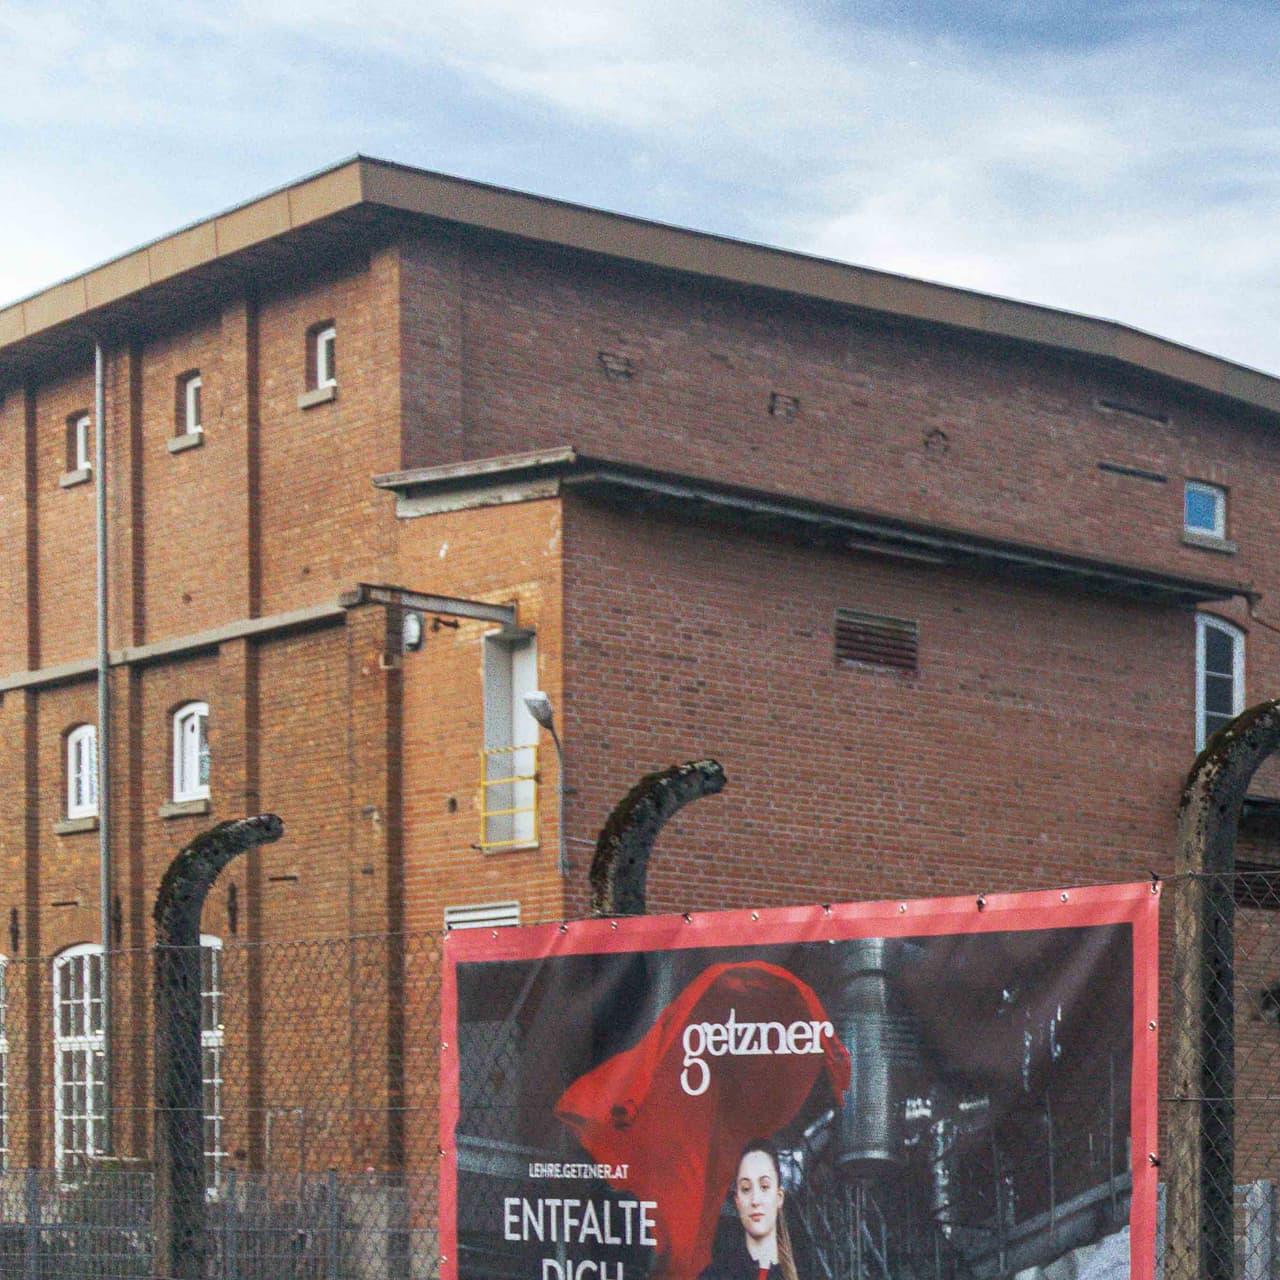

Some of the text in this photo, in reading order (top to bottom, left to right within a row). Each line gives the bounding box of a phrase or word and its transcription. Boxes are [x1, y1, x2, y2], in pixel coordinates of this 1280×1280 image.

[680, 1008, 834, 1096] getzner
[528, 1162, 629, 1180] LEHRE.GETZNER.AT
[504, 1197, 658, 1246] ENTFALTE
